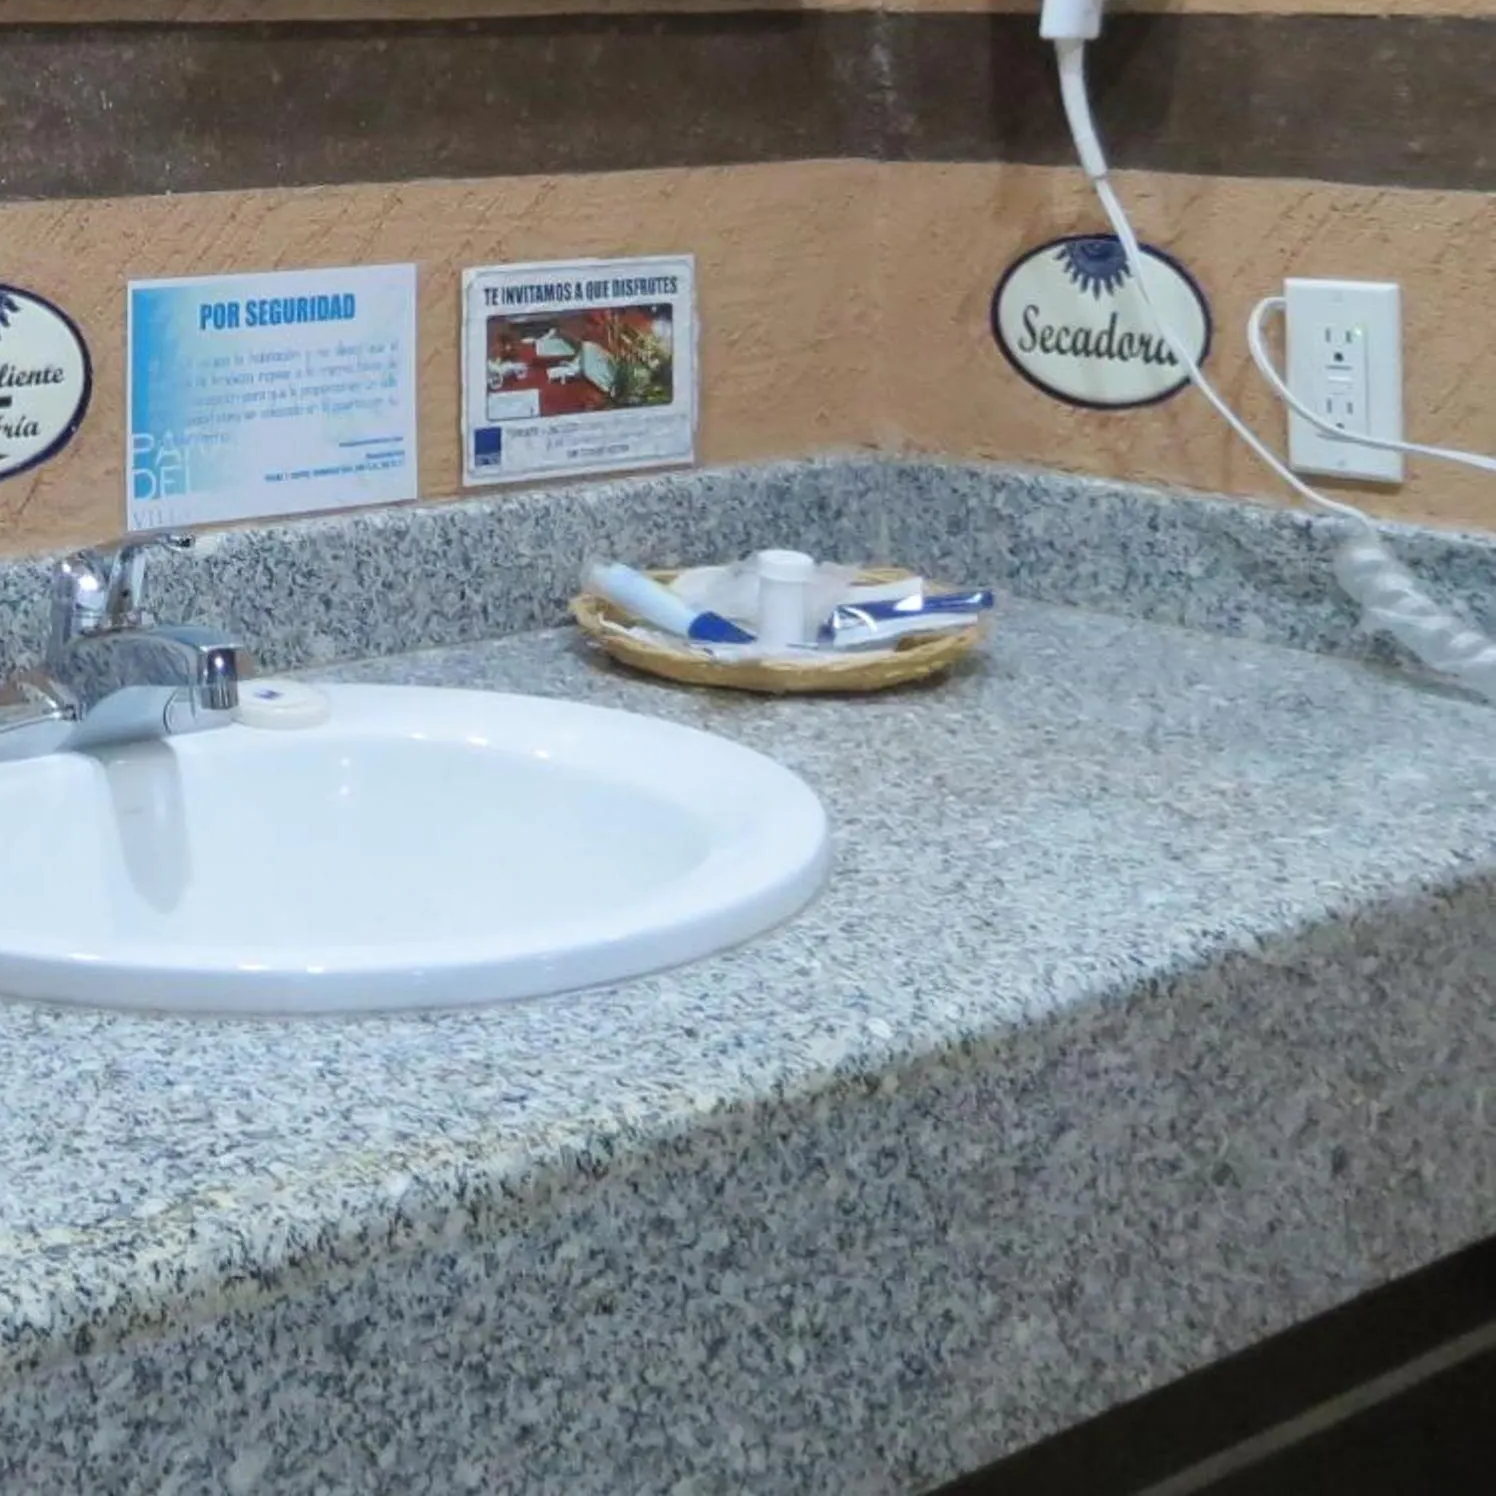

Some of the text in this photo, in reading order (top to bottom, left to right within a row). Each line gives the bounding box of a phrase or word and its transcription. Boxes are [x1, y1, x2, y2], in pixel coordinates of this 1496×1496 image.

[483, 275, 679, 306] TE INVITAMOS A QUE DISFRUTES
[198, 292, 357, 331] POR SEGURIDAD
